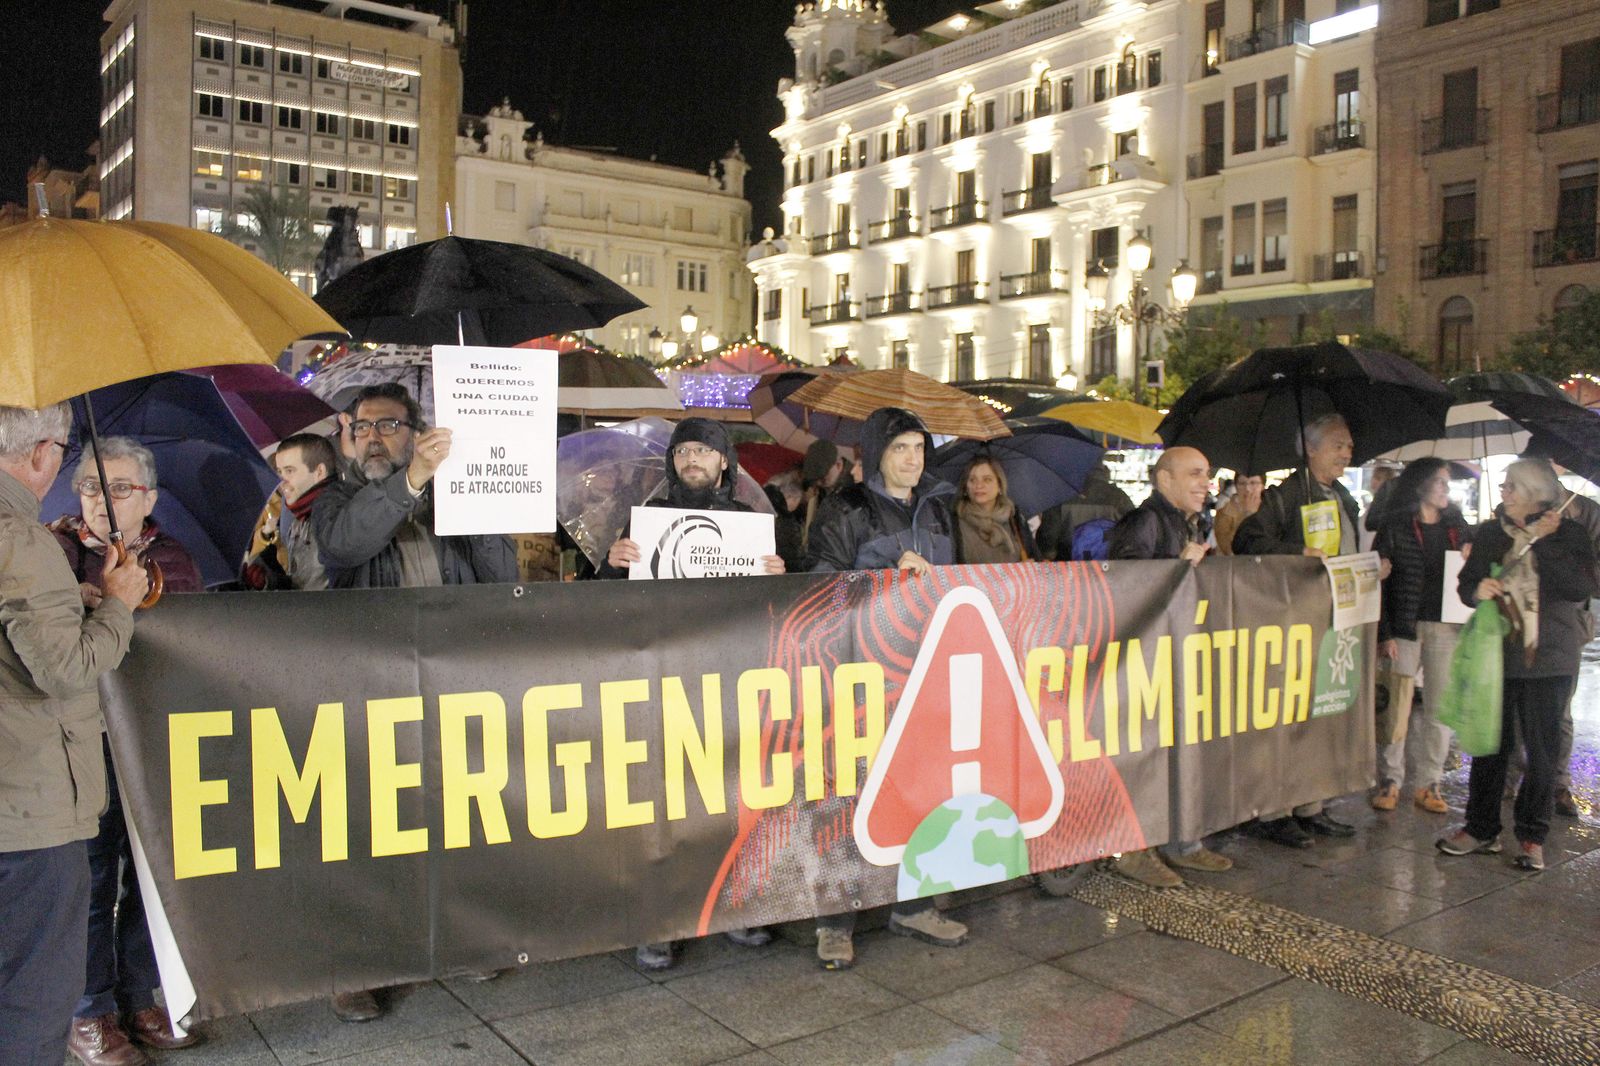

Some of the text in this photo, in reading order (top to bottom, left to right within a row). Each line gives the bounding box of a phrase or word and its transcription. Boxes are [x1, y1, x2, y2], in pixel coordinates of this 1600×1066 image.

[470, 362, 522, 371] Bellido:
[455, 377, 535, 387] QUEREMOS
[452, 392, 539, 402] UNA CIUDAD
[457, 408, 535, 417] HABITABLE
[490, 446, 506, 460] NO
[466, 463, 528, 478] UN PARQUE
[450, 480, 542, 495] DE ATRACCIONES
[690, 545, 721, 555] 2020
[689, 555, 755, 567] REBELIÓN
[168, 599, 1313, 881] EMERGENCIA CLIMÁTICA
